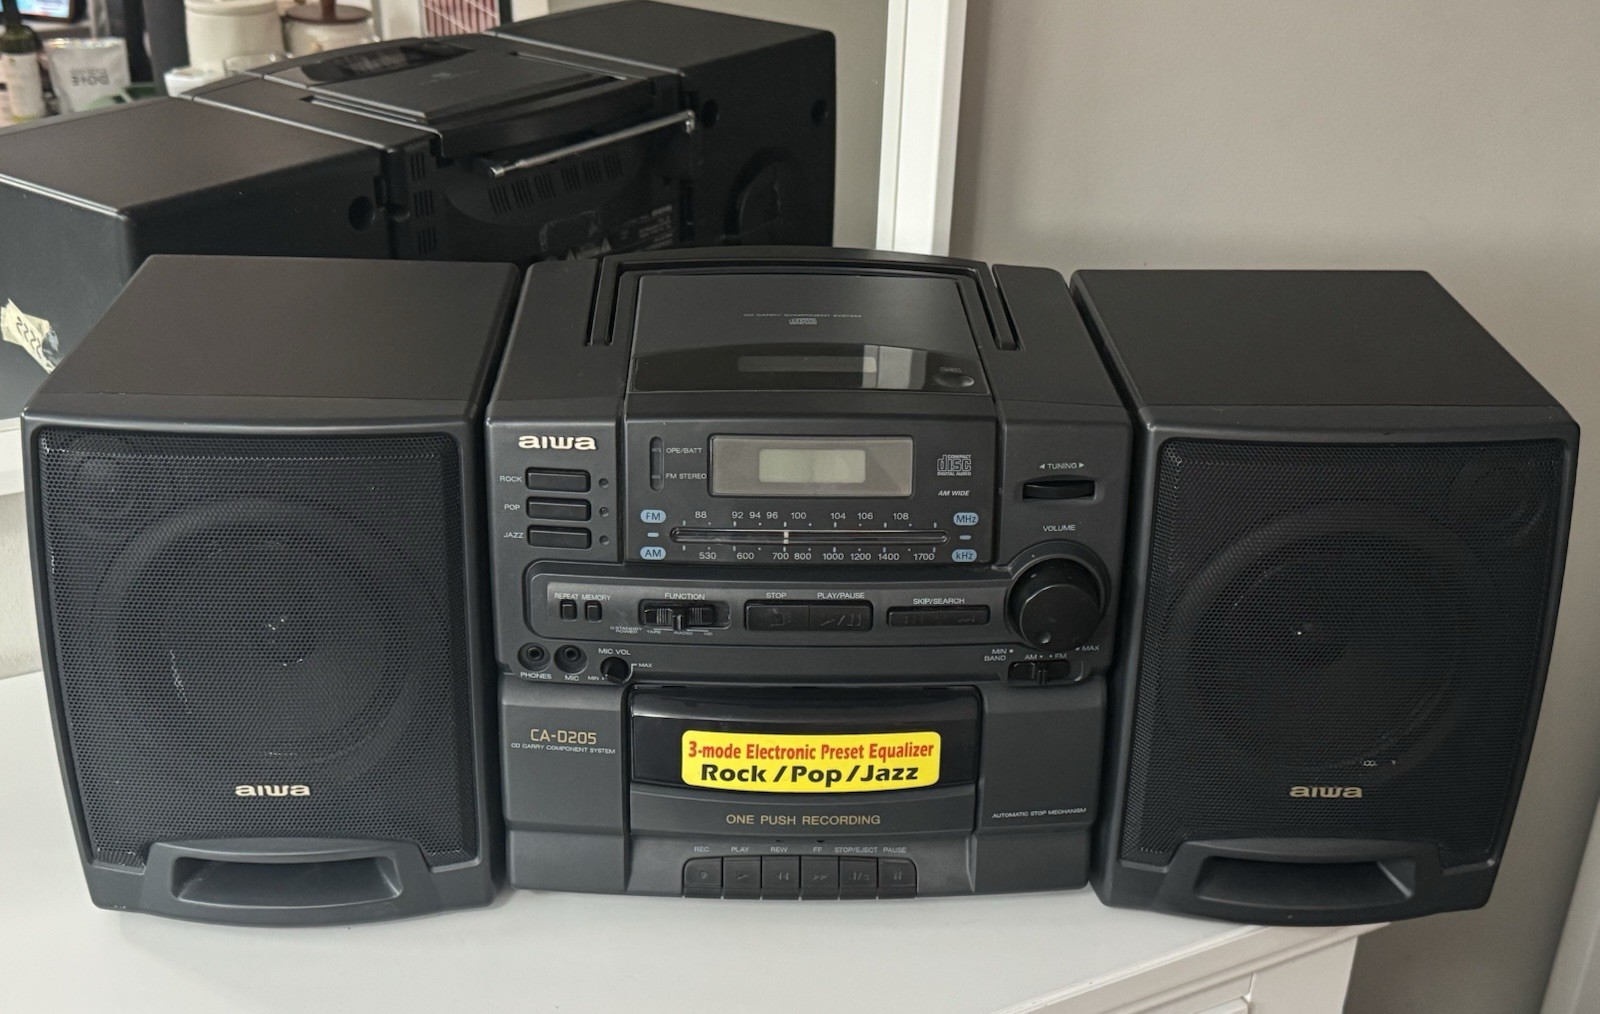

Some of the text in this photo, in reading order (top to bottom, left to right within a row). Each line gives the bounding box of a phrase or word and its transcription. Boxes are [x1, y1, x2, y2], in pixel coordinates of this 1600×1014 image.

[518, 435, 597, 450] aiwa
[936, 454, 972, 472] disc
[1047, 462, 1078, 470] TUNING
[499, 475, 523, 483] ROCK
[665, 472, 708, 480] FM STEREO
[504, 503, 521, 511] POP
[645, 511, 662, 521] FM
[694, 510, 909, 520] 88 92 94 96 100 104 106 108
[956, 513, 977, 524] MHz
[1042, 524, 1076, 533] VOLUME
[503, 531, 524, 539] JAZZ
[644, 548, 662, 558] AM
[699, 551, 935, 560] 530 600 700 800 1000 1200 1400 1700
[955, 550, 974, 561] kHz
[554, 592, 579, 600] REPEAT
[581, 593, 611, 601] MEMORY
[664, 592, 706, 600] FUNCTION
[912, 597, 966, 605] SKIP/SEARCH
[520, 672, 552, 680] PHONES
[564, 674, 580, 682] MIC
[530, 728, 597, 745] CA-D205
[546, 744, 588, 753] COMPONENT
[589, 747, 616, 755] SYSTEM
[688, 740, 935, 763] 3-mode Electronic Preset Equalizer
[701, 764, 767, 783] Rock
[234, 784, 311, 797] aiwa
[1289, 785, 1363, 799] aiwa
[992, 811, 1029, 819] AUTOMATIC
[1048, 807, 1087, 816] MECHANISM
[726, 814, 881, 826] ONE PUSH RECORDING
